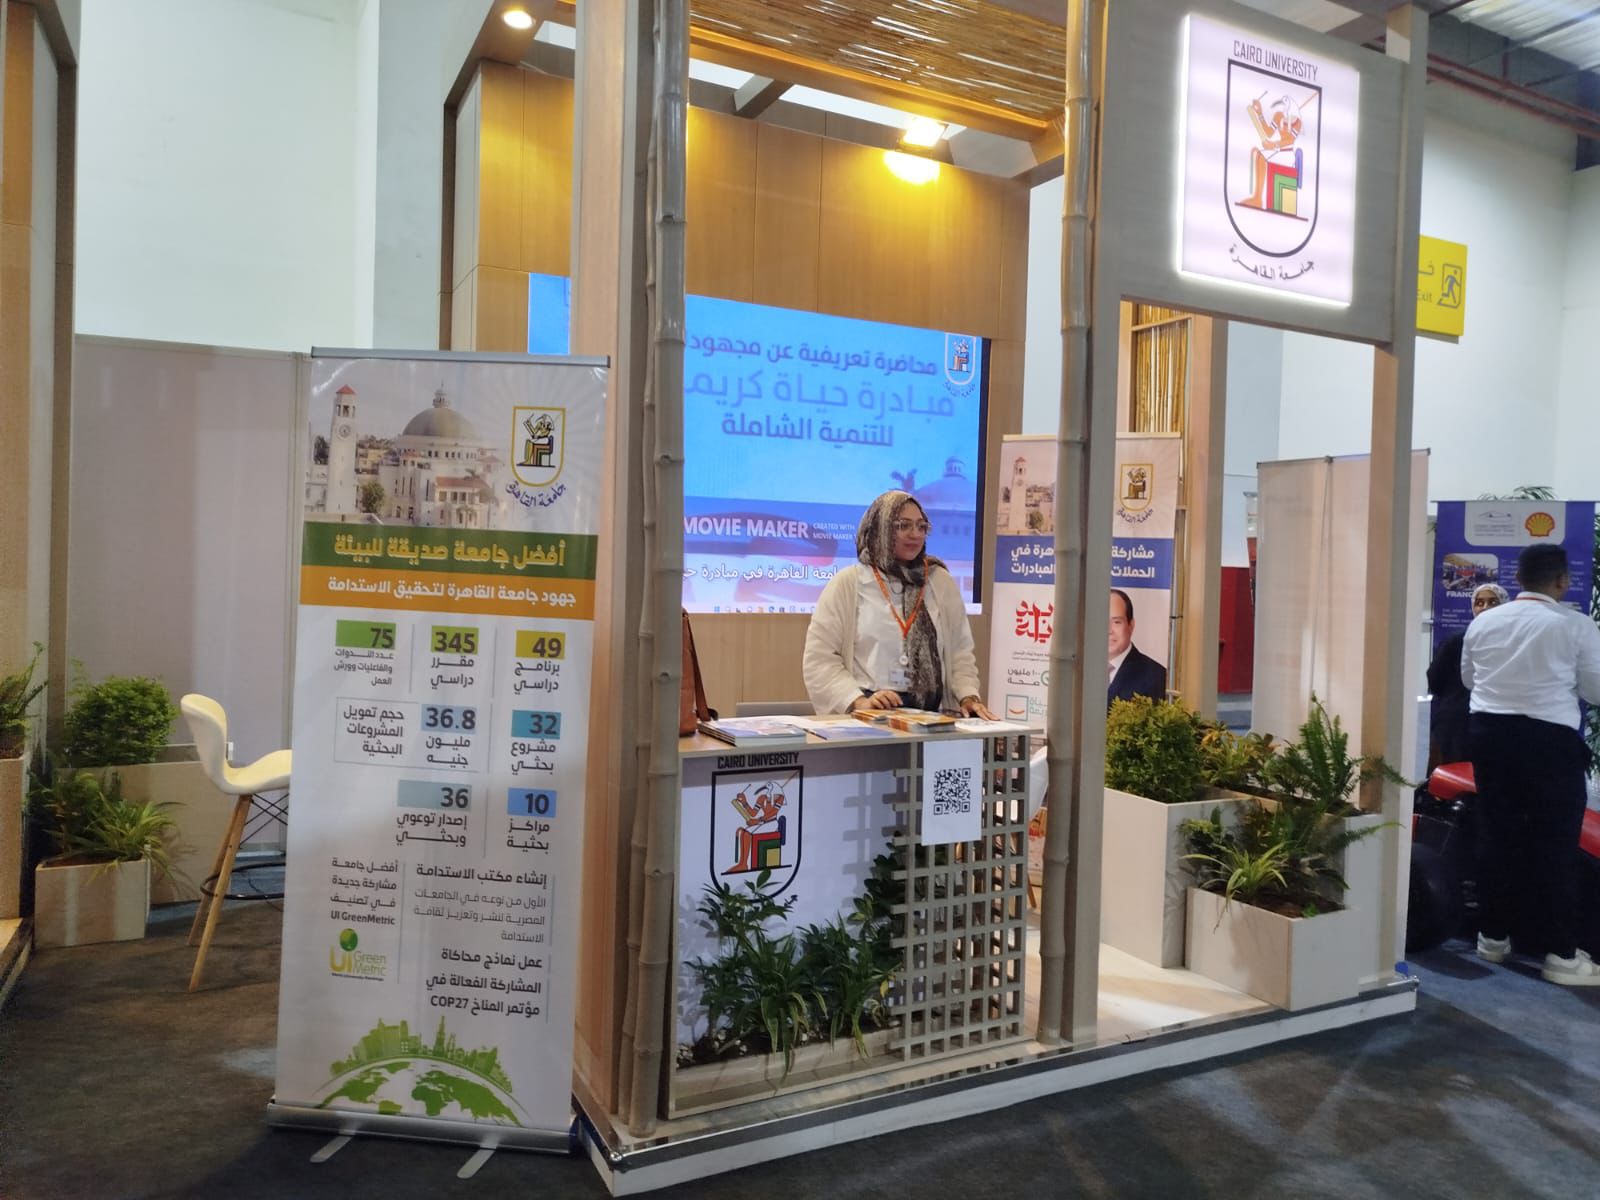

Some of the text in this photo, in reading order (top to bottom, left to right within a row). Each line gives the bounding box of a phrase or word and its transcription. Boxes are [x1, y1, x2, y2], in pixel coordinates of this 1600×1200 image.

[1233, 40, 1318, 82] CAIRO UNIVERSITY
[689, 333, 938, 376] محاضرة تعريفية عن مجهود
[684, 368, 764, 409] كريم
[772, 373, 848, 414] حياة
[858, 380, 956, 423] مبادرة
[721, 412, 894, 449] للتنمية الشاملة
[683, 516, 809, 539] MOVIE MAKER
[333, 533, 566, 570] أفضل جامعة صديقة للبيئة
[1011, 544, 1031, 561] في
[1112, 544, 1155, 562] مشاركة
[702, 563, 739, 581] مبادرة
[743, 565, 764, 582] في
[767, 565, 809, 581] القاهرة
[813, 565, 839, 580] امعة
[1111, 566, 1155, 579] الحملات
[328, 576, 576, 607] جهود جامعة القاهرة لتحقيق الاستدامة
[1446, 590, 1472, 598] FRANC
[370, 628, 394, 649] 75
[433, 631, 476, 653] 345
[531, 637, 562, 659] 49
[431, 656, 475, 669] مقرر
[514, 660, 560, 677] برنامج
[371, 676, 392, 687] العمل
[430, 673, 474, 690] دراسي
[513, 678, 559, 695] دراسي
[343, 705, 405, 722] حجم تمويل
[425, 707, 476, 730] 36.8
[347, 723, 404, 739] المشروعات
[529, 714, 558, 735] 32
[362, 740, 402, 757] البحثية
[425, 736, 471, 751] مليون
[511, 738, 556, 757] مشروع
[426, 754, 468, 769] جنيه
[511, 756, 554, 776] بحثي
[717, 752, 800, 769] CAIRO UNIVERSITY
[440, 787, 469, 809] 36
[525, 793, 550, 815] 10
[438, 815, 468, 831] إصدار
[508, 818, 550, 833] مراكز
[396, 828, 466, 847] وبحثي
[507, 835, 549, 855] بحثية
[331, 857, 398, 874] أفضل جامعة
[331, 875, 397, 892] مشاركة جديدة
[416, 863, 547, 890] إنشاء مكتب الاستدامة
[330, 893, 396, 911] في تصنيف
[414, 888, 459, 901] الجامعات
[460, 893, 479, 905] في
[505, 897, 522, 908] من
[331, 910, 396, 925] UI GreenMetric
[501, 930, 544, 943] الاستدامة
[354, 950, 386, 964] Green
[441, 948, 543, 970] عمل نماذج محاكاة
[425, 973, 542, 994] المشاركة الفعالة في
[430, 995, 540, 1018] مؤتمر المناخ COP27
